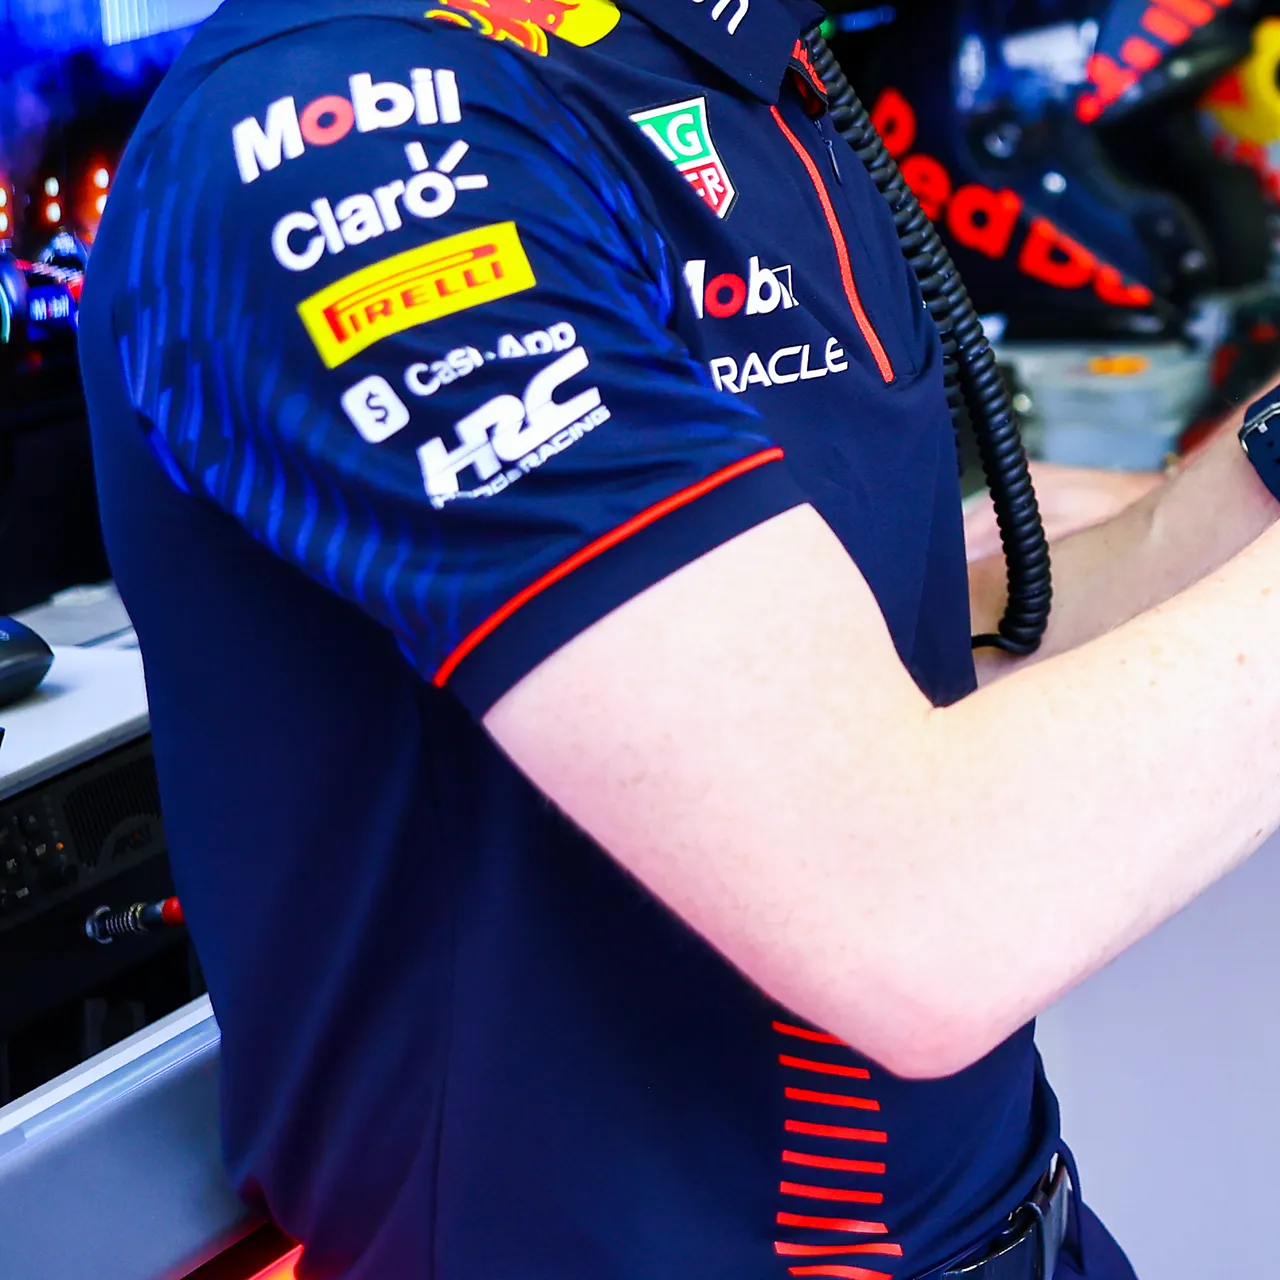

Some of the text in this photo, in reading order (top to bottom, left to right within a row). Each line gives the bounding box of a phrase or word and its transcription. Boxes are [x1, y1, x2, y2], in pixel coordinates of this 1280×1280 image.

[231, 67, 462, 184] Mobil
[271, 170, 458, 272] Claro
[321, 243, 505, 344] PIRELLI
[708, 336, 849, 395] RACLE
[415, 345, 602, 497] HRC
[517, 404, 612, 474] RACING
